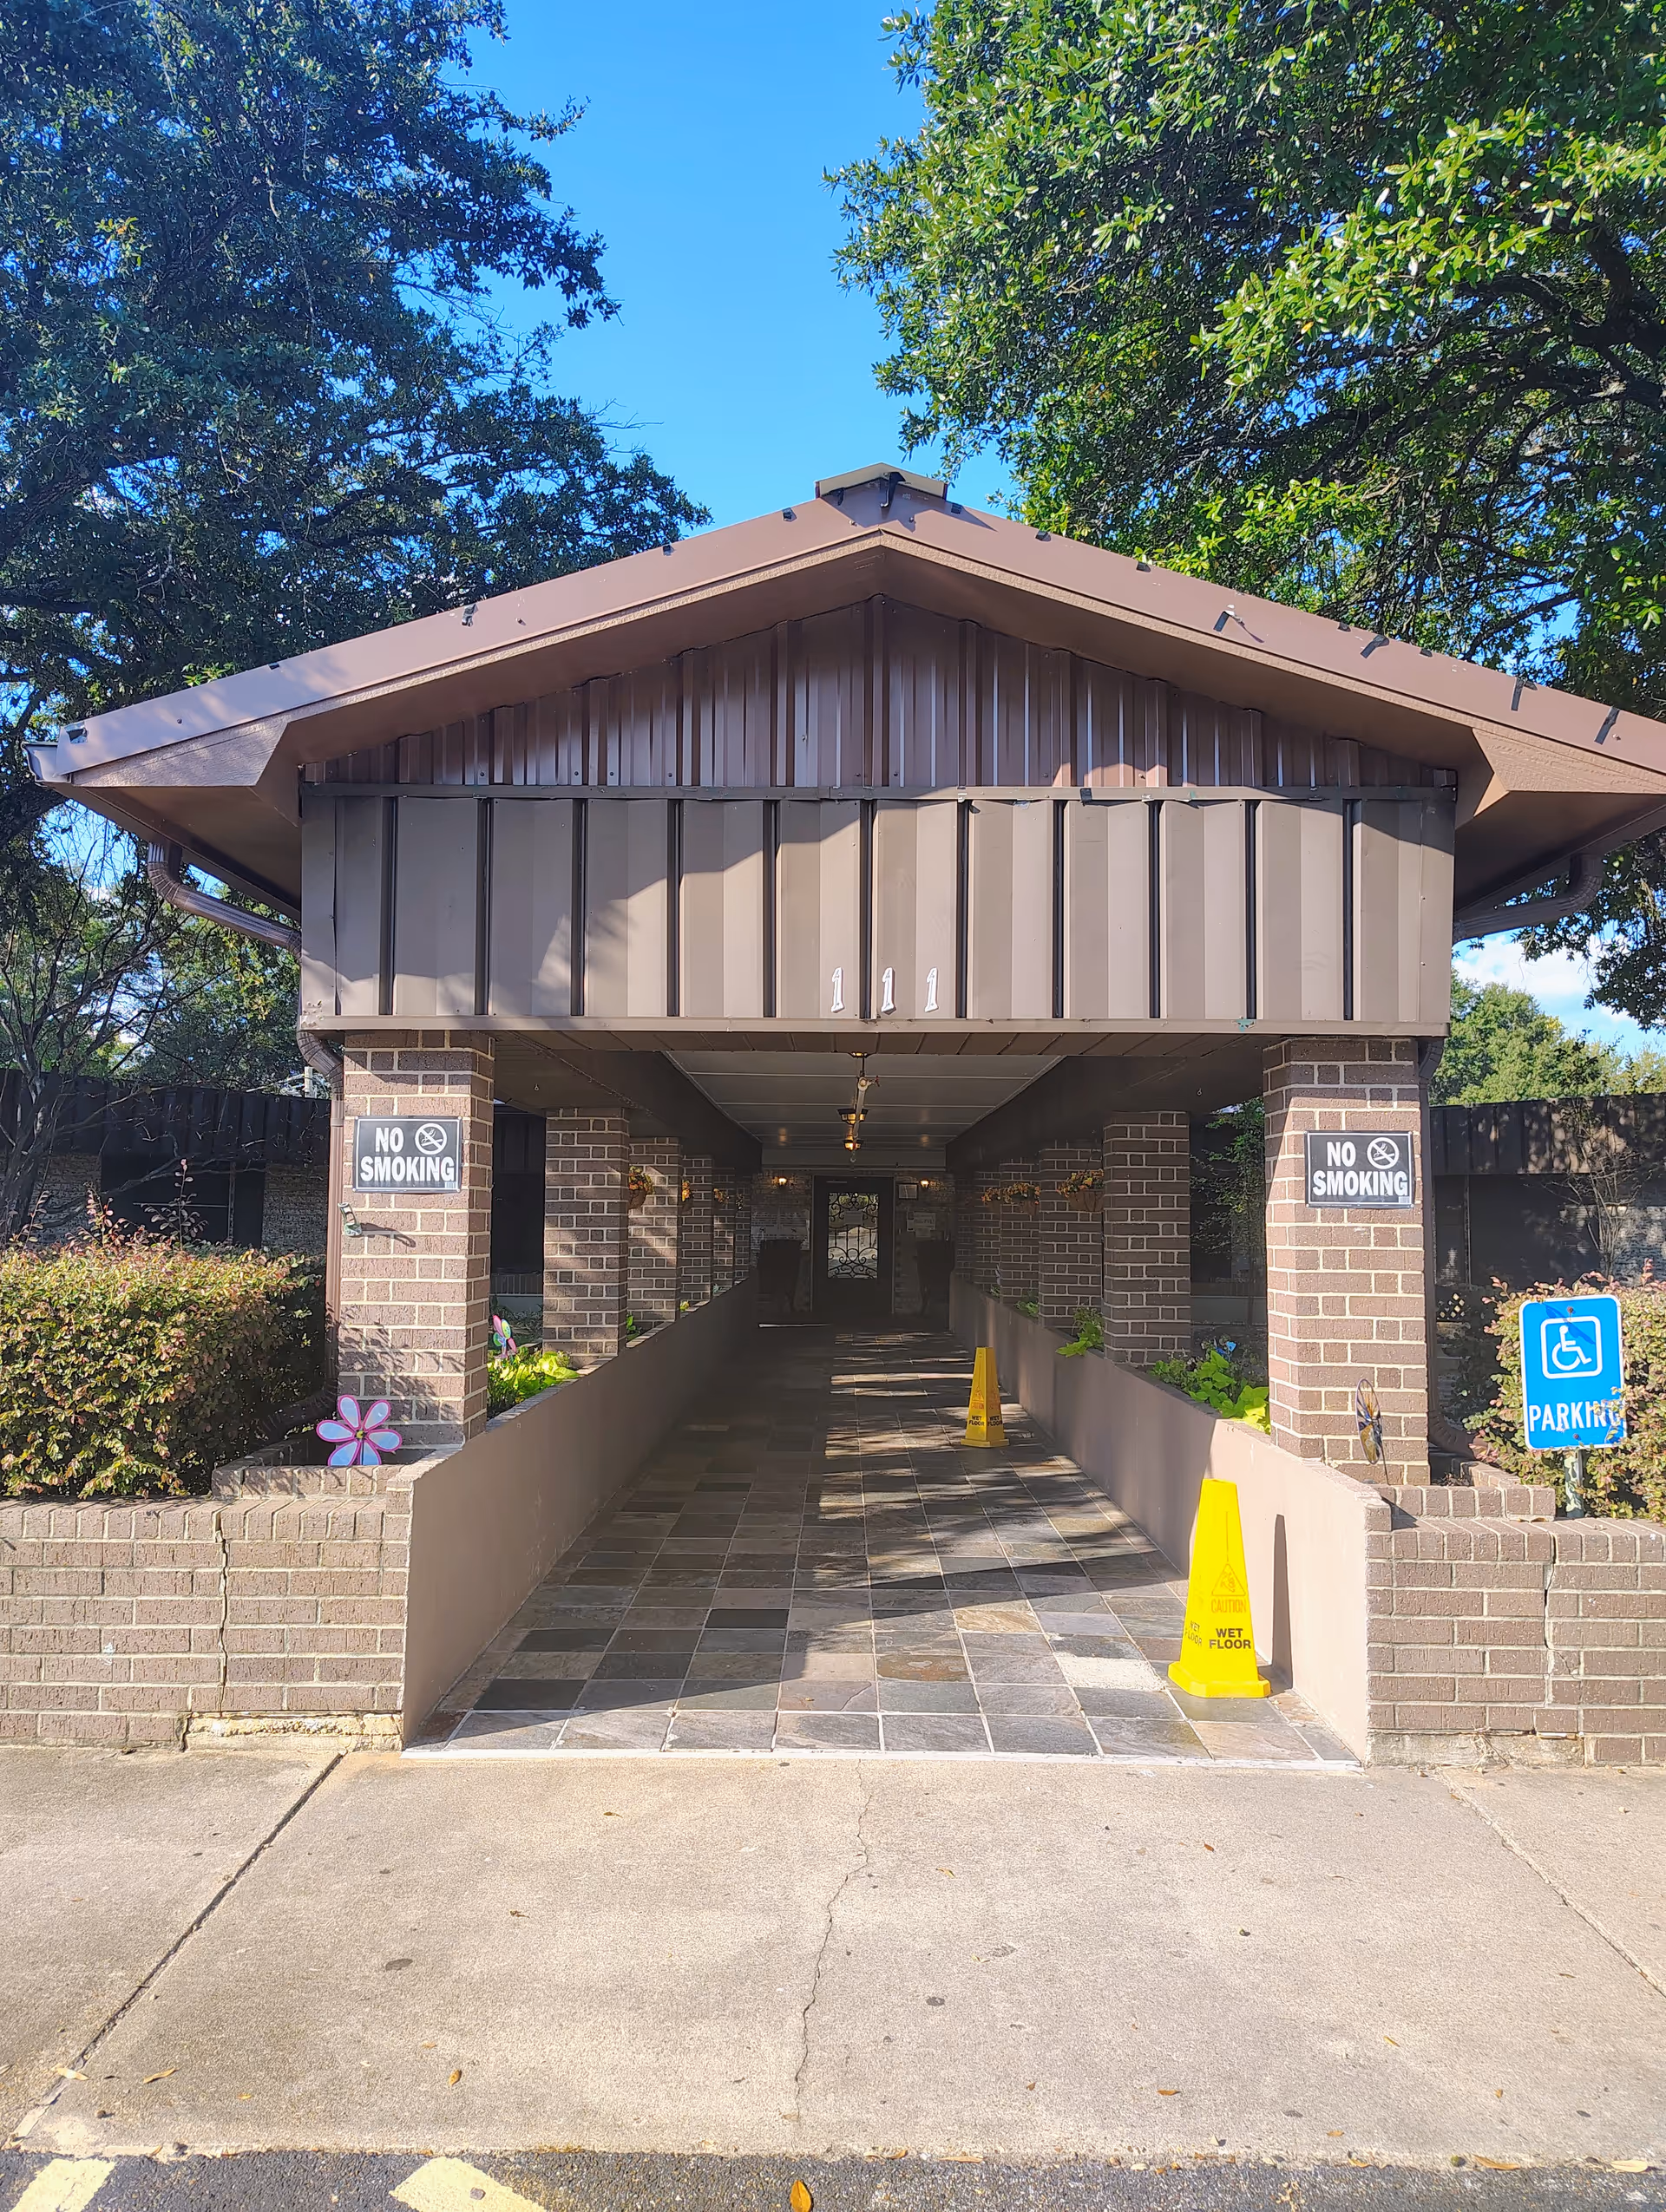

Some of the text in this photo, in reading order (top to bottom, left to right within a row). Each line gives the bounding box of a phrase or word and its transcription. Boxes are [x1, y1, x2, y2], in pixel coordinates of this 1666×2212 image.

[375, 1127, 404, 1153] NO
[1327, 1141, 1356, 1167] NO
[360, 1155, 455, 1181] SMOKING
[1312, 1170, 1408, 1196] SMOKING
[1211, 1599, 1247, 1613] CAUTION
[1209, 1639, 1251, 1649] FLOOR
[1216, 1628, 1243, 1638] WET
